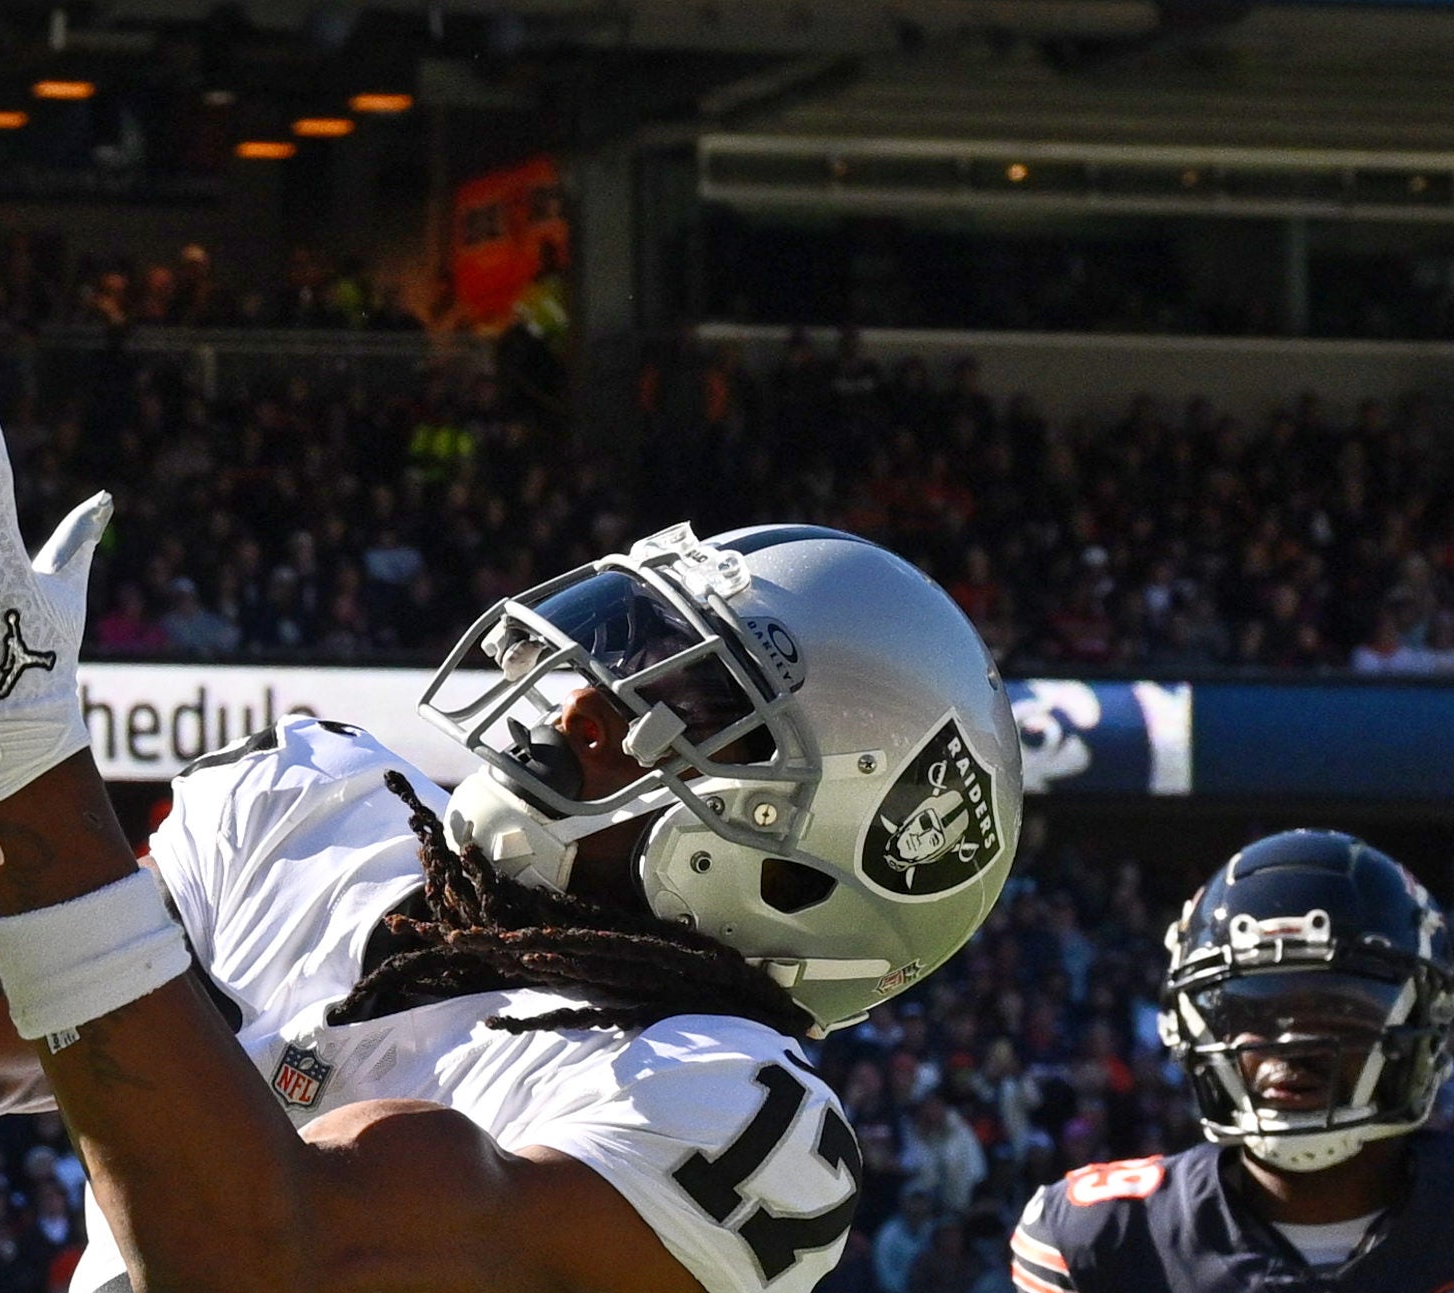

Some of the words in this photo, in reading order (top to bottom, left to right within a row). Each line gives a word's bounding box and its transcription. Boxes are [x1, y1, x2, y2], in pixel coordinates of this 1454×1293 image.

[747, 620, 792, 681] OAKLEY
[947, 736, 996, 850] RAIDERS
[276, 1065, 314, 1103] NFL
[670, 1062, 864, 1284] 17
